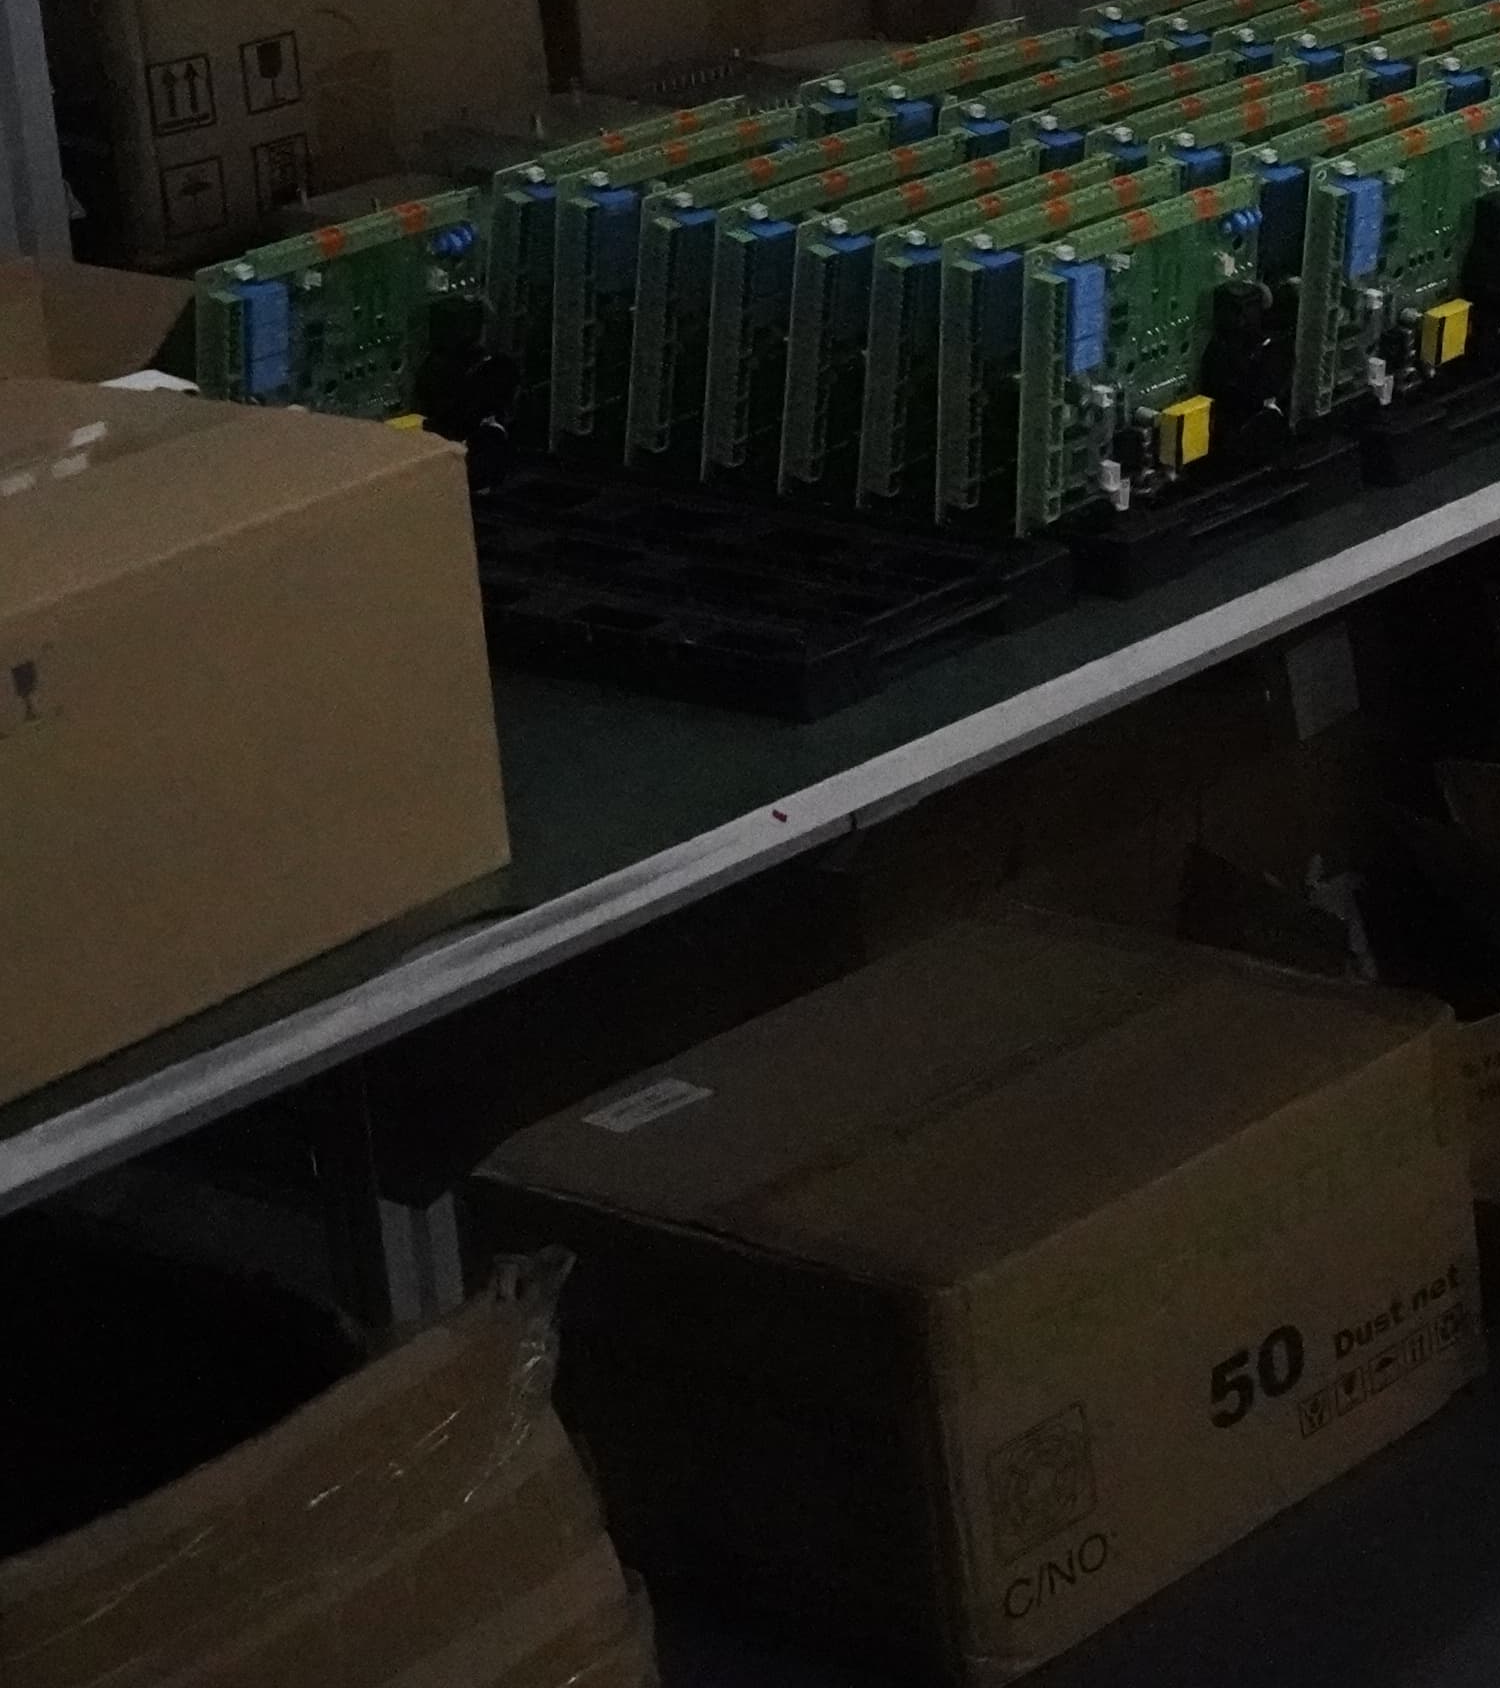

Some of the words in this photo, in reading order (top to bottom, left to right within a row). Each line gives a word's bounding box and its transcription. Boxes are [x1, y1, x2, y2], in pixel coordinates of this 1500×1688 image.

[1210, 1325, 1305, 1429] 50
[1334, 1303, 1402, 1359] Dust
[1412, 1263, 1459, 1312] net
